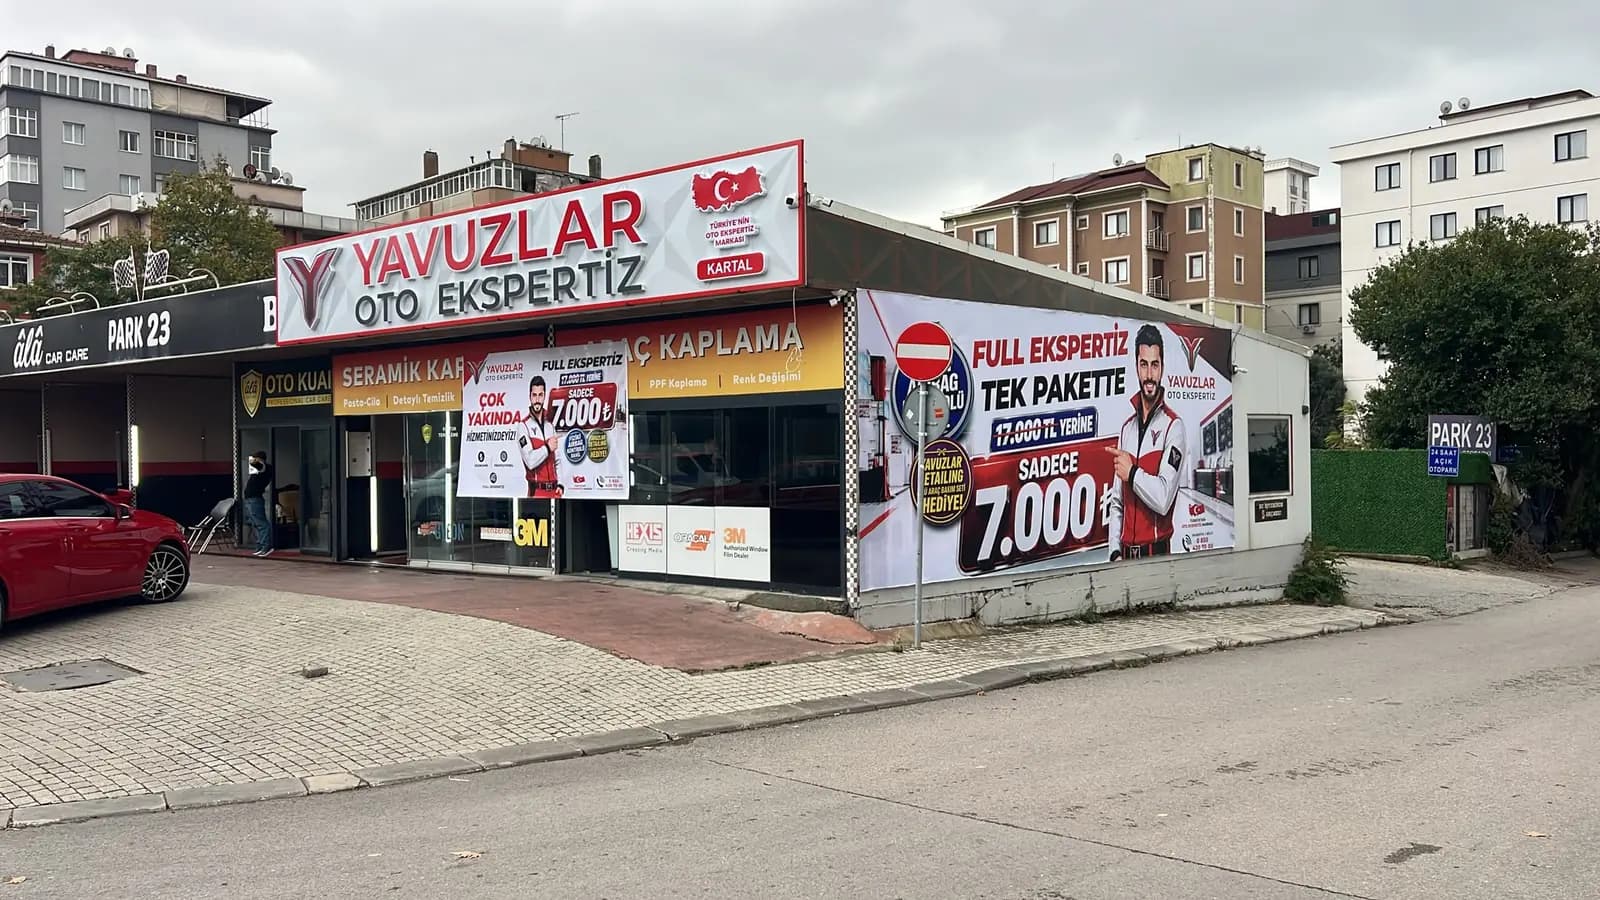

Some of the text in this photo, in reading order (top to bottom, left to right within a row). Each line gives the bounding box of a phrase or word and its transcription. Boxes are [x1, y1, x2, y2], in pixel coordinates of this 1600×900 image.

[352, 188, 646, 287] YAVUZLAR
[705, 225, 755, 239] OTO EKSPERTİZ
[715, 236, 745, 246] MARKASI
[707, 258, 753, 276] KARTAL
[355, 248, 646, 326] OTO EKSPERTİZ
[108, 311, 171, 351] PARK 23
[660, 322, 804, 361] KAPLAMA
[972, 322, 1129, 369] FULL EKSPERTİZ
[45, 348, 89, 365] CAR CARE
[541, 351, 623, 371] FULL EKSPERTİZ
[342, 356, 422, 388] SERAMİK
[486, 363, 523, 373] YAVUZLAR
[733, 371, 801, 385] Renk Değişimi
[265, 373, 294, 393] OTO
[649, 378, 708, 389] PPF Kaplama
[981, 377, 1027, 412] TEK
[1032, 367, 1126, 406] PAKETTE
[1167, 375, 1216, 389] YAVUZLAR
[393, 391, 455, 405] Detaylı Temizlik
[479, 392, 506, 411] ÇOK
[568, 387, 595, 398] SADECE
[1167, 390, 1216, 400] OTO EKSPERTİZ
[467, 411, 522, 426] YAKINDA
[551, 397, 600, 428] 7.000
[994, 412, 1093, 447] 17.000 TL YERİNE
[1432, 423, 1492, 448] PARK 23
[1018, 451, 1078, 481] SADECE
[924, 469, 964, 486] ETAILING
[923, 494, 964, 514] HEDİYE!
[976, 473, 1096, 561] 7.000
[516, 518, 549, 546] 3M
[626, 522, 663, 545] HEXIS
[724, 528, 746, 544] 3M
